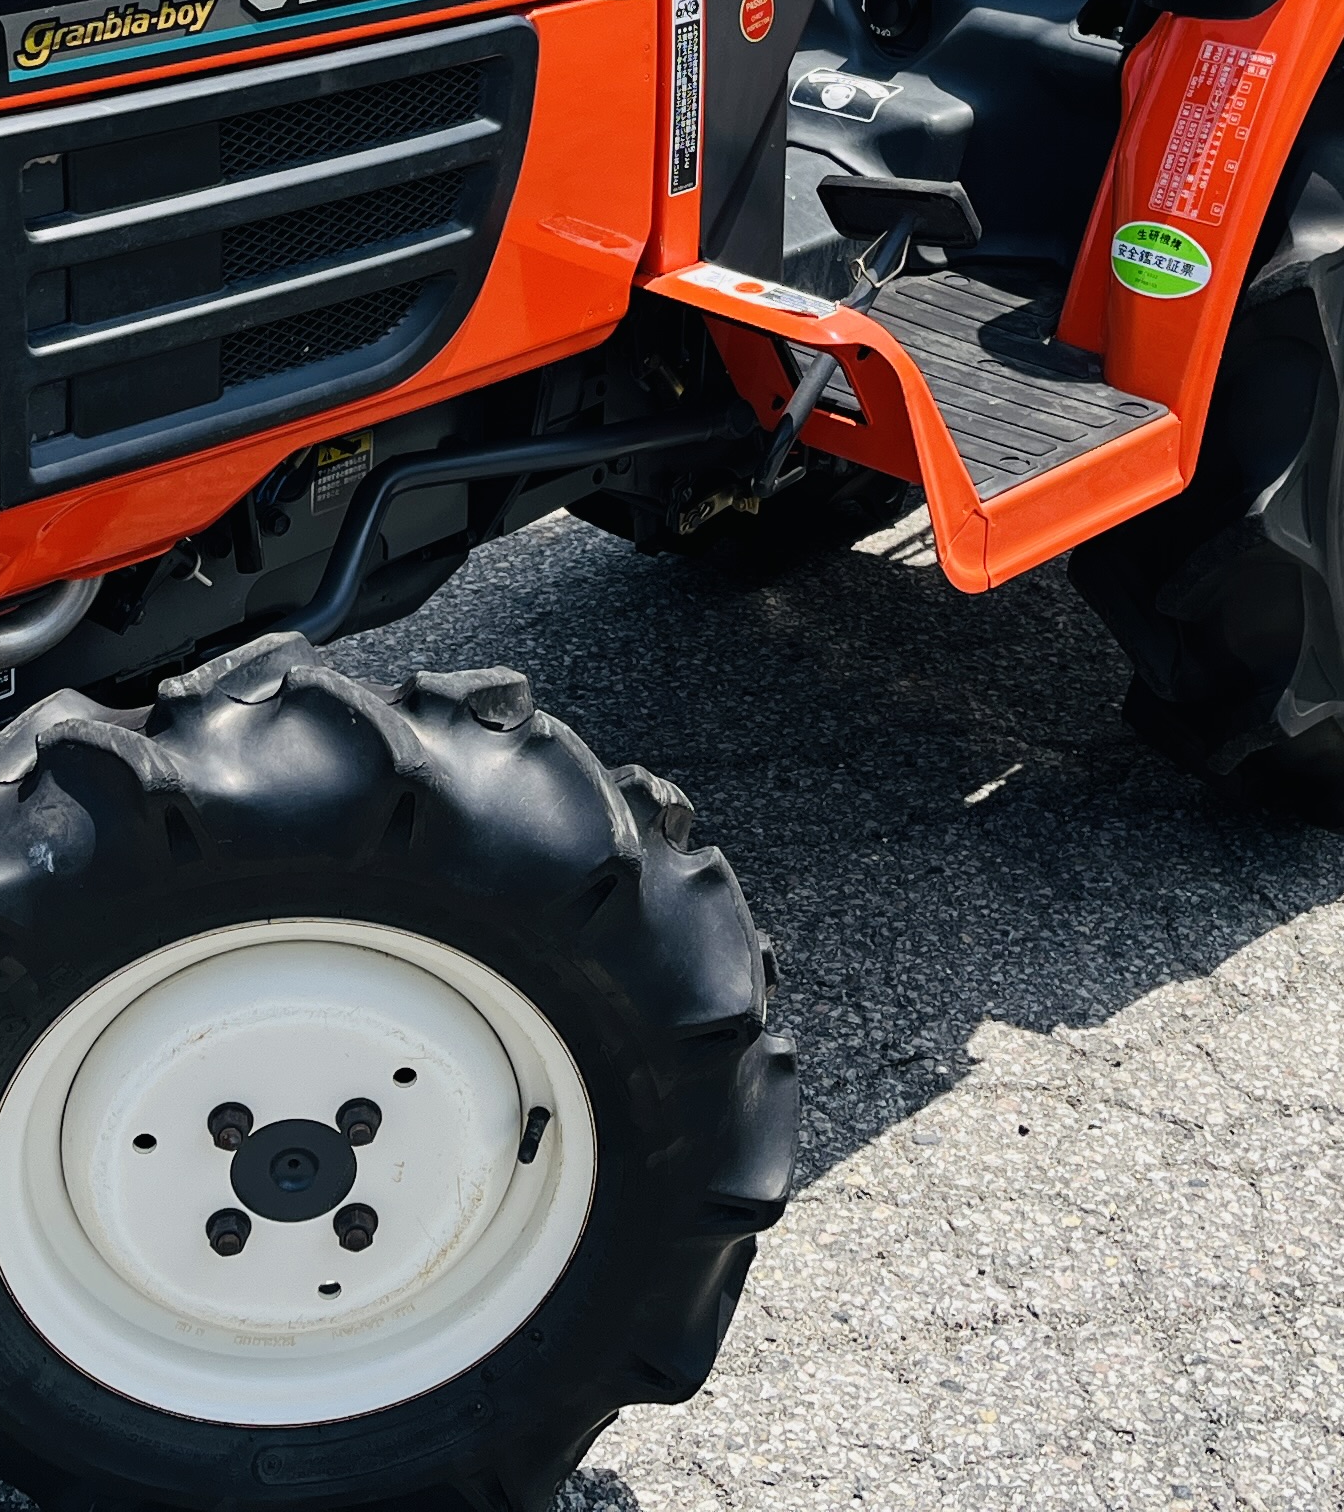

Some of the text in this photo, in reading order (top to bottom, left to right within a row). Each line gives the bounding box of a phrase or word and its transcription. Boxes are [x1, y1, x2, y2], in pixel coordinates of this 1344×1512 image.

[1117, 243, 1196, 278] 安全鑑定証票
